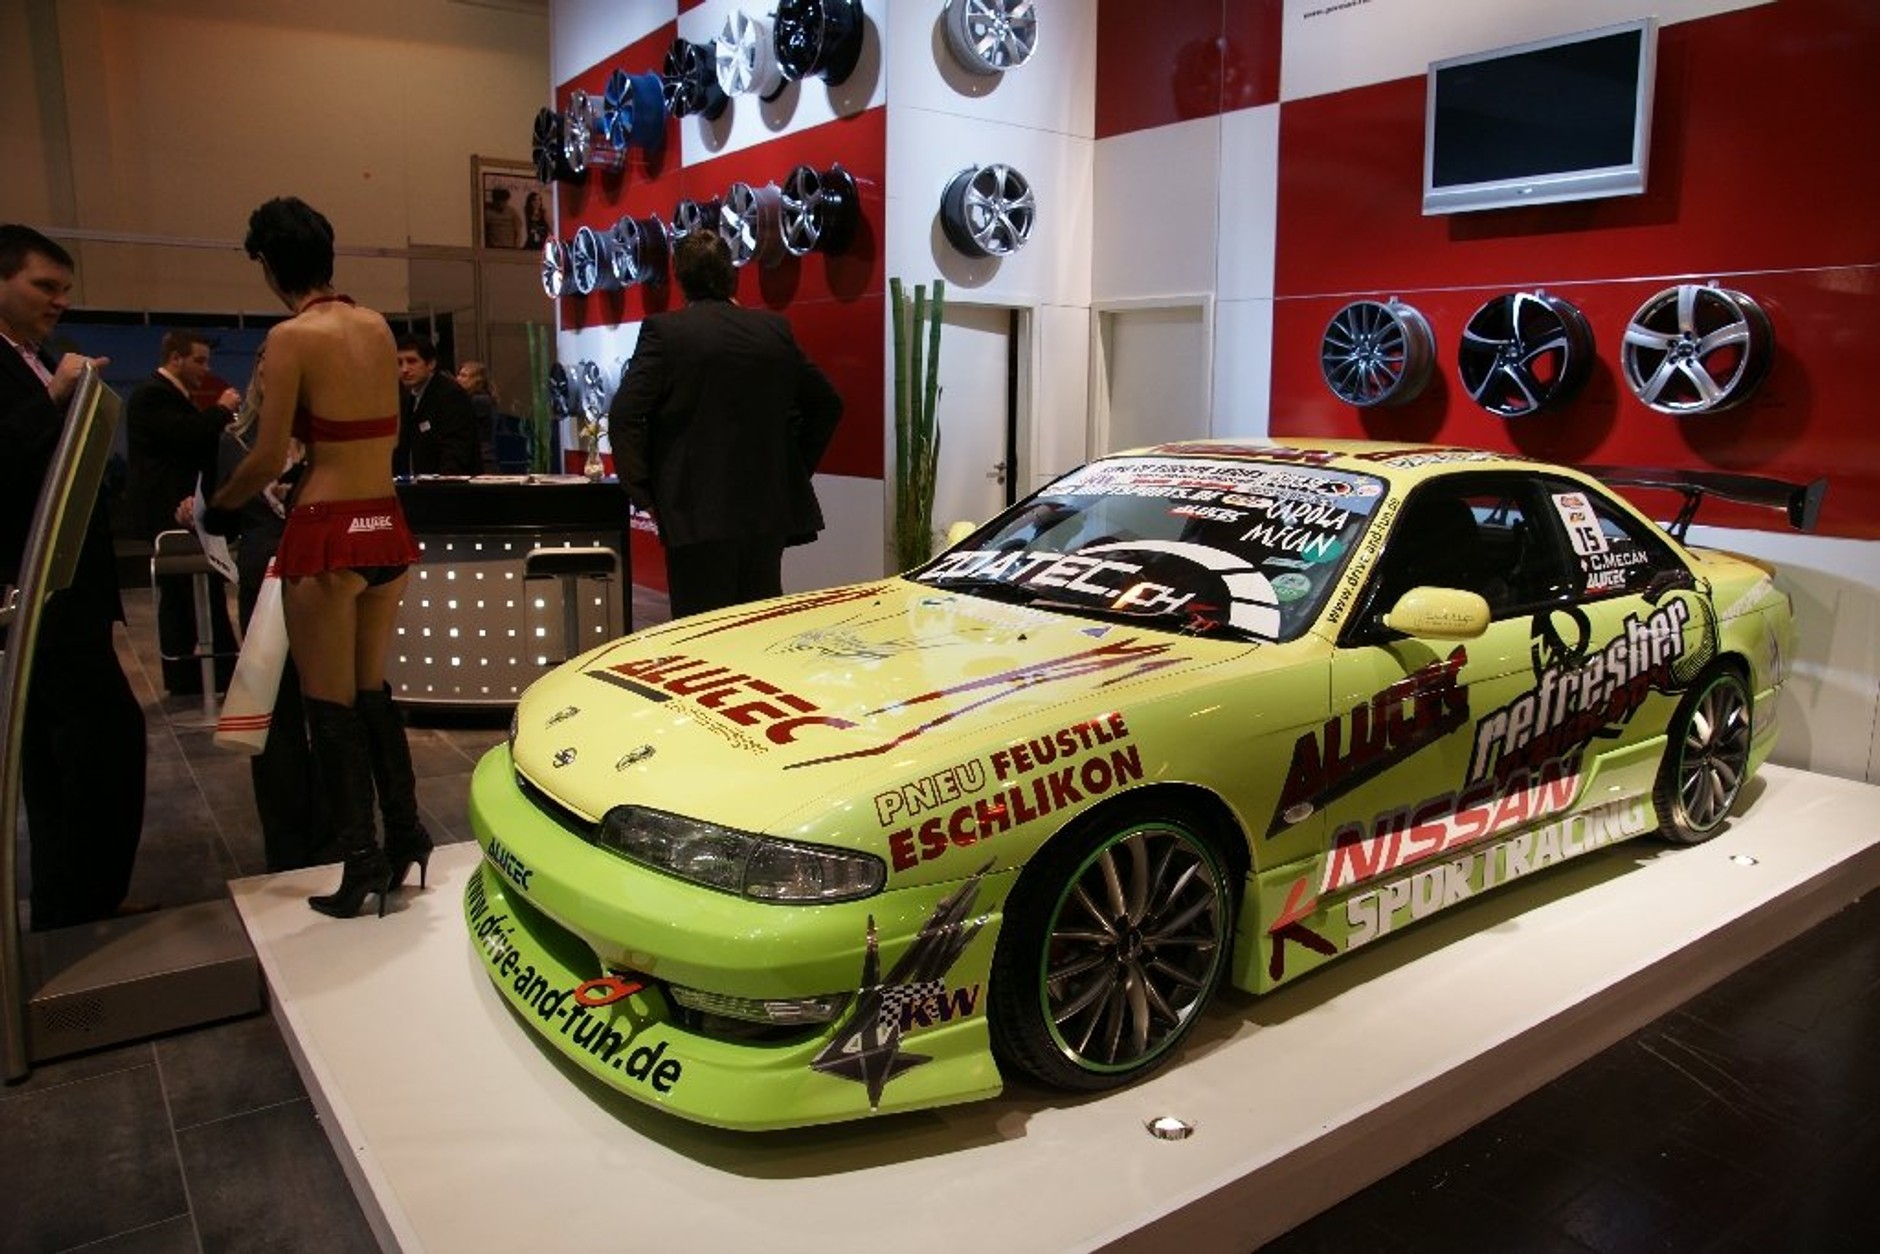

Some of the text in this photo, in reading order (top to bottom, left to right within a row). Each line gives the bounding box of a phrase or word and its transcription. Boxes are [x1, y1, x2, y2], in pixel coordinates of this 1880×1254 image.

[348, 515, 393, 533] ALUTEC
[1575, 526, 1601, 552] 15
[607, 655, 860, 745] ALUTEC
[1466, 597, 1690, 786] refresher
[874, 711, 1129, 827] PNEU FEUSTLE
[888, 744, 1145, 872] ESCHLIKON
[1320, 759, 1584, 893] NISSAN
[488, 837, 534, 892] ALUTEC
[1346, 795, 1646, 948] SPORTRACING
[466, 868, 683, 1093] www.drive-and-fun.de
[899, 984, 980, 1032] KW
